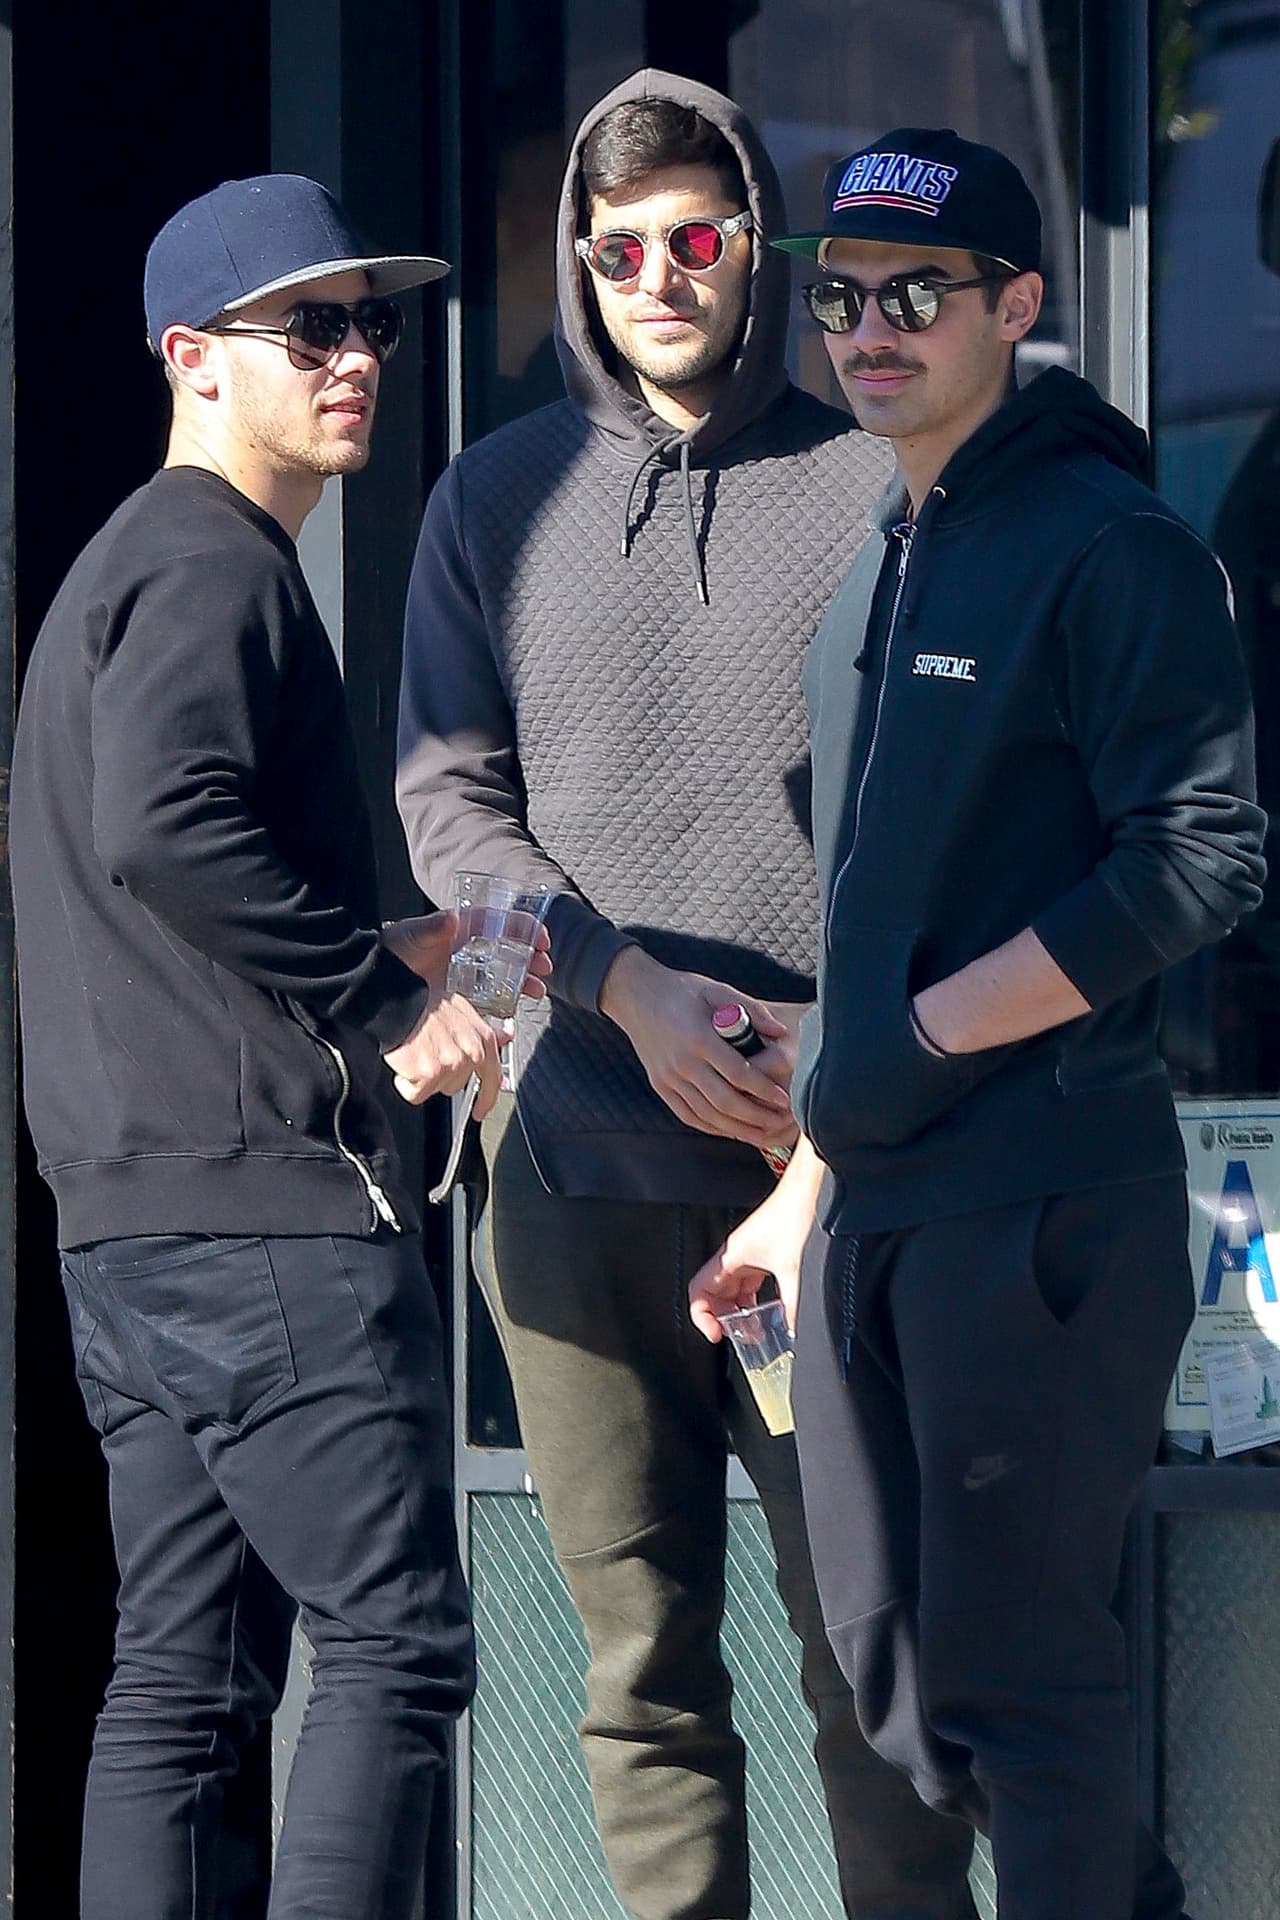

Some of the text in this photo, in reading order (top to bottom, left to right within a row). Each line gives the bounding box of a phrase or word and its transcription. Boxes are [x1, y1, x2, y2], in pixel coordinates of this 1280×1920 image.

[837, 153, 959, 203] GIANTS
[912, 653, 977, 682] SUPREME
[1200, 1160, 1278, 1306] A
